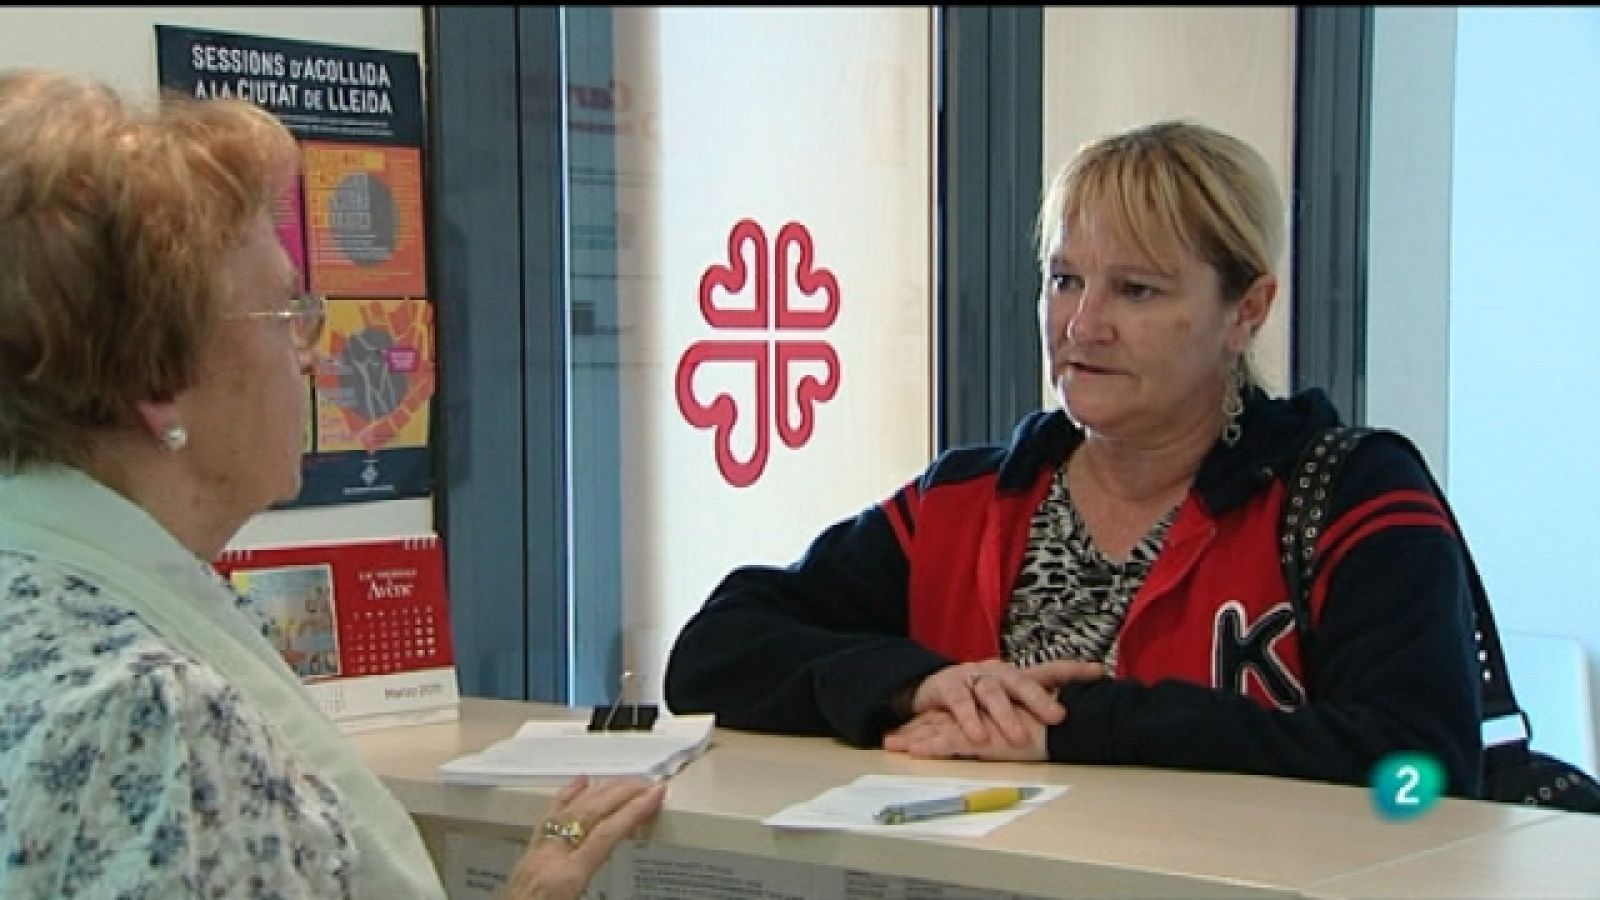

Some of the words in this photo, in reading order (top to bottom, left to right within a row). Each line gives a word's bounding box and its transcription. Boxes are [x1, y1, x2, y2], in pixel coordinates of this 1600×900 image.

[192, 44, 286, 77] SESSIONS
[195, 77, 208, 101] A
[237, 77, 298, 109] CIUTAT
[304, 88, 323, 111] DE
[326, 86, 393, 114] LLEIDA
[1211, 599, 1306, 714] K
